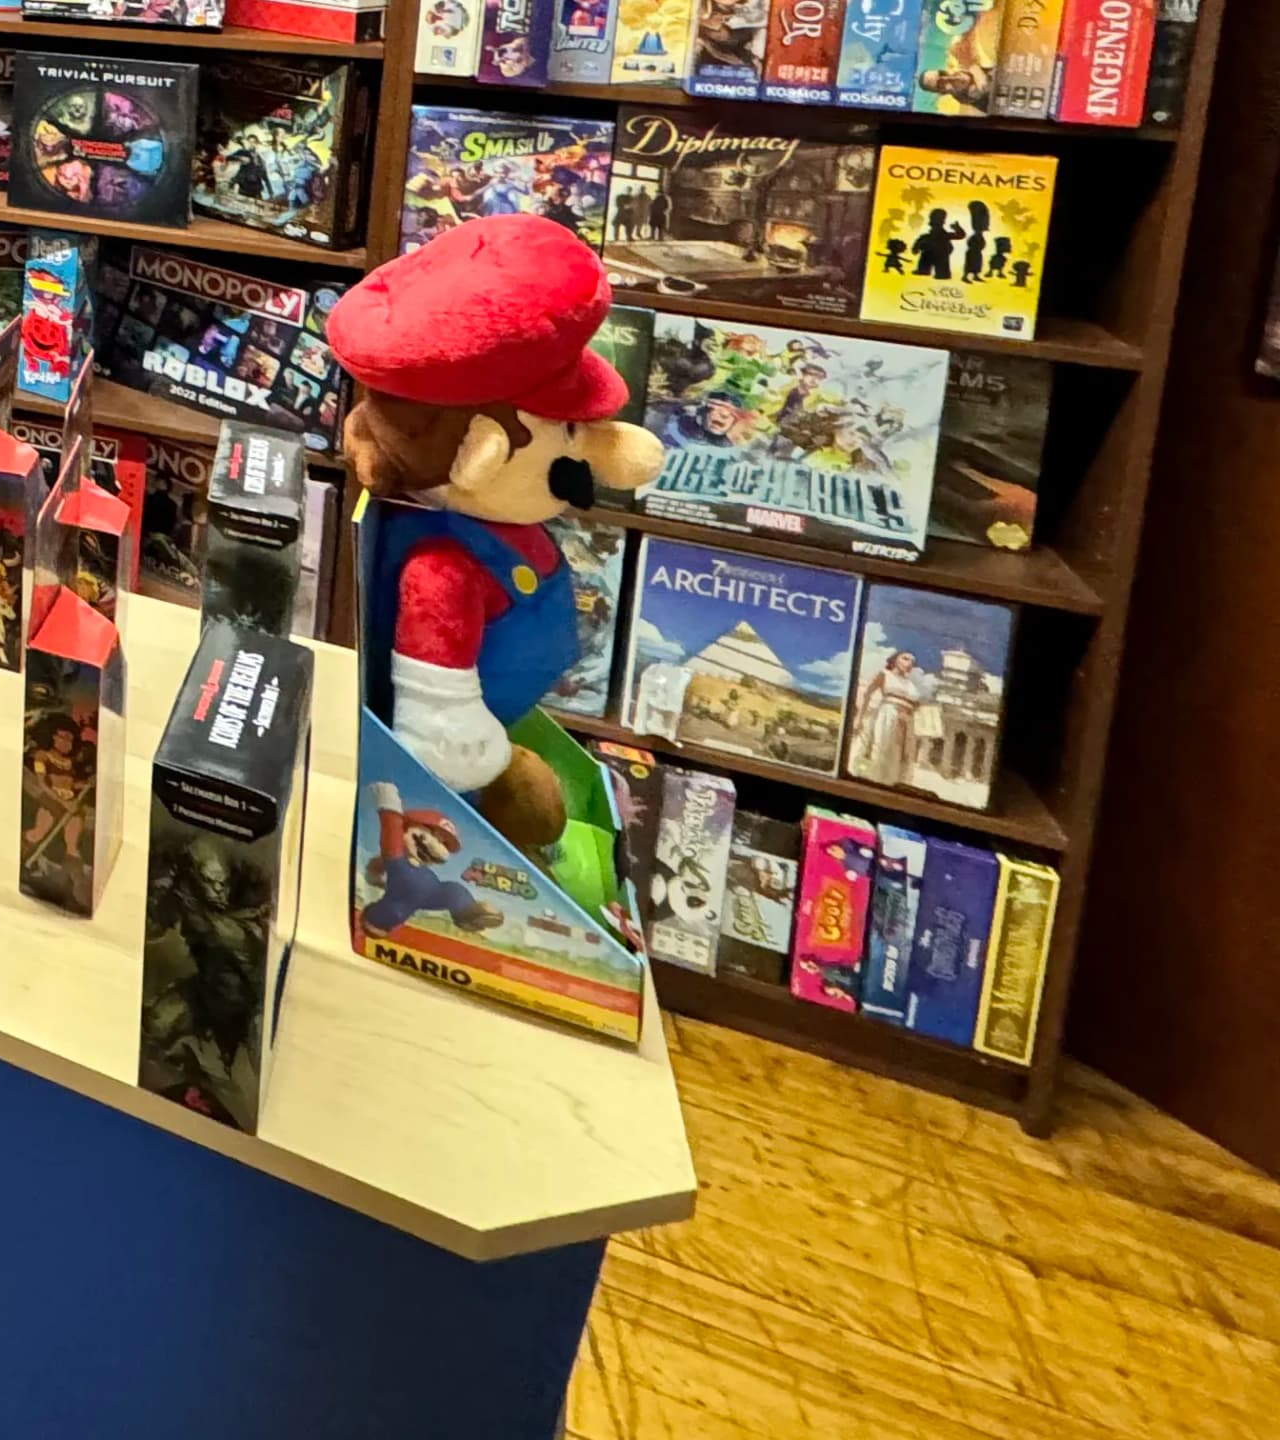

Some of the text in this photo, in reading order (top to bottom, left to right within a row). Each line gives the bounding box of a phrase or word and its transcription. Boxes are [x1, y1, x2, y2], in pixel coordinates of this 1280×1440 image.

[38, 67, 177, 88] TRIVIAL PURSUIT
[695, 83, 757, 97] KOSMOS
[766, 86, 831, 102] KOSMOS
[840, 91, 906, 106] KOSMOS
[460, 131, 535, 163] SMASH
[623, 114, 799, 178] Diplomacy
[888, 164, 1047, 192] CODENAMES
[136, 252, 302, 320] MONOPOLY
[143, 351, 273, 411] ROBLOX
[168, 383, 237, 416] 2022 Edition
[656, 448, 730, 497] AGE
[729, 464, 757, 502] OF
[757, 466, 913, 534] HEROES
[746, 506, 807, 534] MARVEL
[711, 560, 724, 578] 7
[650, 565, 847, 623] ARCHITECTS
[374, 943, 473, 986] MARIO
